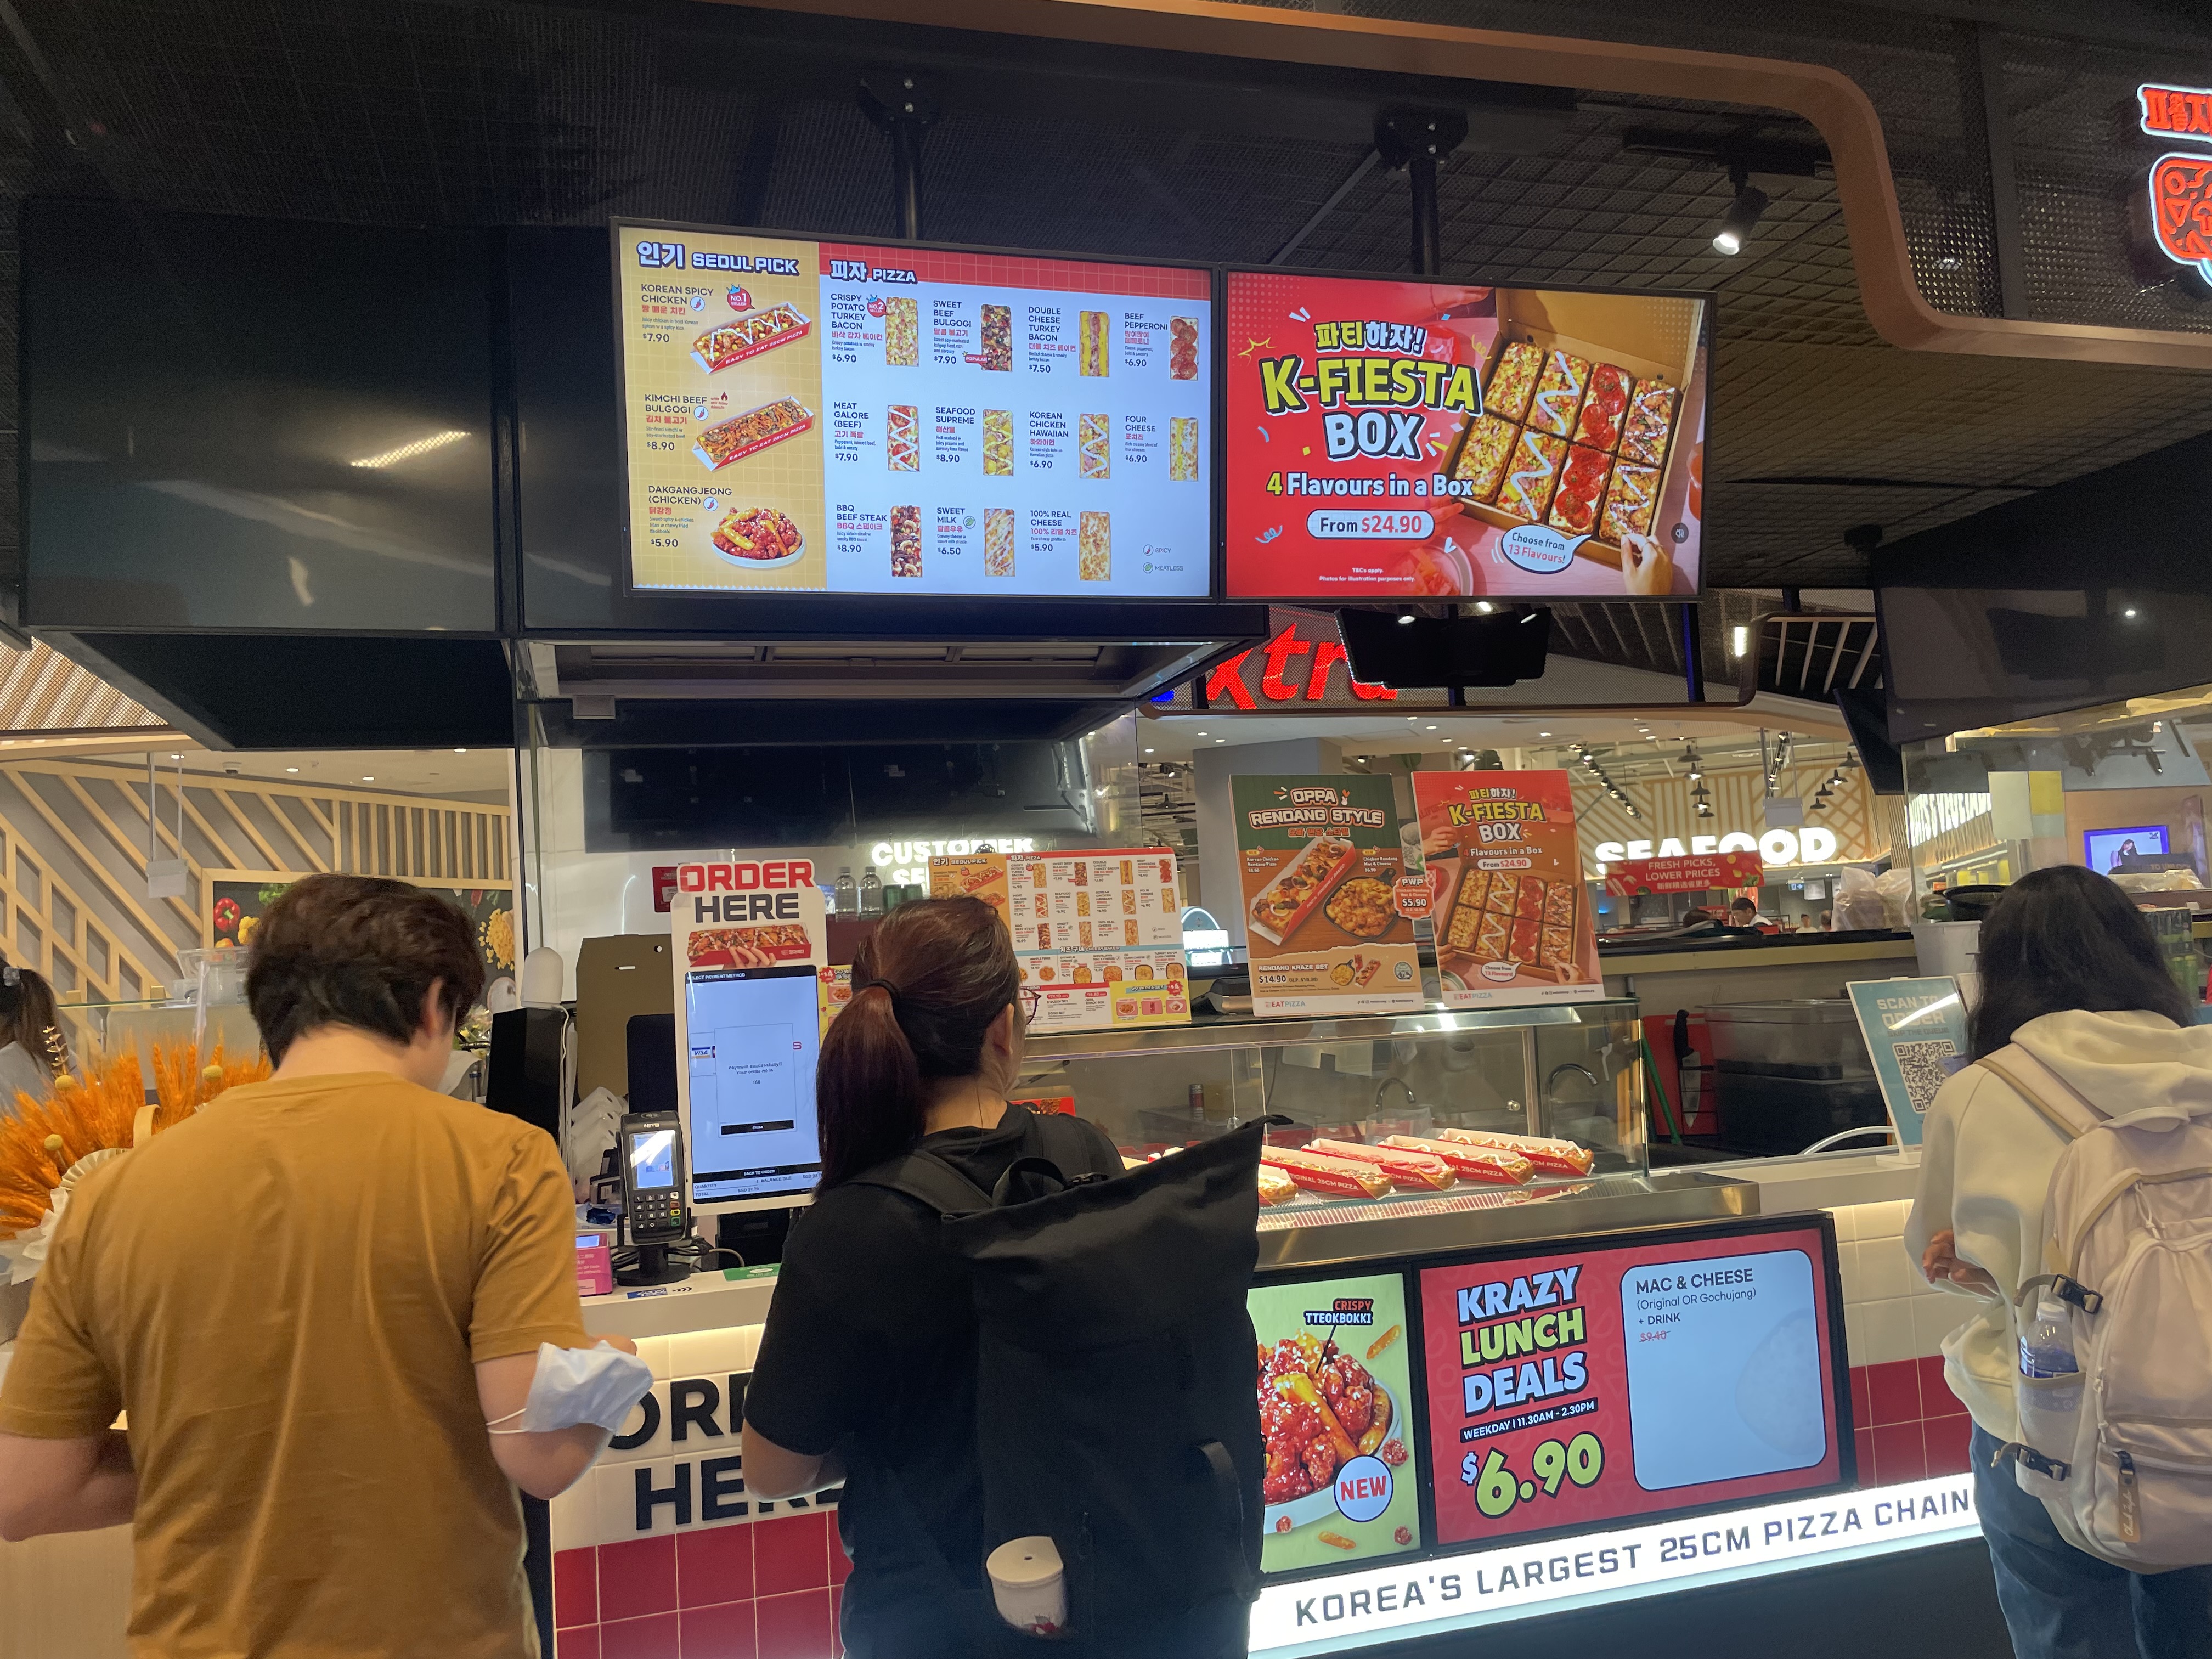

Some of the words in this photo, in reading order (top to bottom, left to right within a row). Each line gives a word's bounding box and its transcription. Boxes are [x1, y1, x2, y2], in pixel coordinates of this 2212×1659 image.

[637, 241, 685, 269] 인기
[692, 252, 753, 273] SEOUL
[755, 257, 800, 275] PICK
[830, 259, 867, 283] 피자
[872, 268, 918, 284] PIZZA
[641, 284, 682, 294] KOREAN
[685, 287, 713, 296] SPICY
[641, 295, 687, 304] CHICKEN
[731, 293, 747, 303] NO.1
[831, 303, 865, 311] POTATO
[1029, 306, 1061, 314] DOUBLE
[831, 312, 866, 320] TURKEY
[1029, 315, 1060, 324] CHEESE
[934, 319, 971, 328] BULGOGI
[643, 334, 669, 342] $7.90
[1315, 320, 1426, 355] 파티하자!
[726, 355, 744, 364] EASY
[756, 343, 768, 352] EAT
[769, 336, 786, 347] 25CM
[787, 330, 803, 340] PIZZA
[832, 354, 856, 363] $6.90
[1125, 359, 1147, 367] $6.90
[1260, 356, 1480, 415] K-FIESTA
[645, 394, 680, 403] KIMCHI
[683, 396, 707, 404] BEEF
[645, 405, 690, 414] BULGOGI
[936, 407, 975, 415] SEAFOOD
[834, 420, 861, 428] (BEEF)
[936, 416, 974, 424] SUPREME
[1323, 411, 1424, 459] BOX
[647, 442, 675, 450] $8.90
[835, 453, 858, 462] $7.90
[936, 454, 960, 463] $8.90
[1030, 460, 1052, 469] $6.90
[1266, 472, 1283, 496] 4
[1286, 472, 1385, 496] Flavours
[1389, 473, 1410, 496] in
[1414, 479, 1426, 496] a
[1432, 474, 1474, 496] Box
[648, 486, 732, 495] DAKGANGJEONG
[648, 496, 701, 505] (CHICKEN)
[1321, 517, 1358, 532] From
[1362, 515, 1421, 533] $24.90
[651, 539, 678, 548] $5.90
[1512, 532, 1543, 546] Choose
[1545, 539, 1565, 550] from
[837, 544, 861, 552] $8.90
[938, 547, 961, 555] $6.50
[1031, 544, 1053, 552] $5.90
[1508, 544, 1520, 555] 13
[1522, 545, 1565, 564] Flavours!
[1291, 788, 1338, 805] OPPA
[1469, 788, 1517, 800] 파티하자!
[1250, 808, 1328, 827] RENDANG
[1331, 809, 1384, 827] STYLE
[1448, 802, 1547, 827] K-FIESTA
[1479, 823, 1523, 842] BOX
[1470, 848, 1508, 856] Flavours
[1527, 846, 1542, 854] Box
[1595, 827, 1837, 874] SEAFOOD
[1649, 860, 1680, 870] FRESH
[1684, 858, 1716, 868] PICKS,
[680, 861, 814, 892] ORDER
[1646, 871, 1682, 881] LOWER
[1685, 868, 1720, 878] PRICES
[1402, 878, 1423, 886] PWP
[695, 893, 799, 923] HERE
[1402, 898, 1427, 907] $5.90
[1876, 997, 1917, 1010] SCAN
[1636, 1277, 1672, 1294] MAC
[1677, 1276, 1687, 1289] &
[1691, 1268, 1753, 1288] CHEESE
[1458, 1265, 1581, 1324] KRAZY
[1637, 1297, 1679, 1311] (Original
[1683, 1295, 1697, 1305] OR
[1700, 1288, 1756, 1303] Gochujang)
[1334, 1299, 1372, 1311] CRISPY
[1305, 1312, 1372, 1324] TTEOKBOKKI
[1648, 1313, 1680, 1325] DRINK
[1460, 1307, 1585, 1368] LUNCH
[1640, 1330, 1667, 1342] $9.40
[1463, 1351, 1587, 1415] DEALS
[1464, 1423, 1510, 1440] WEEKDAY
[1517, 1410, 1554, 1427] 11.30AM
[1561, 1401, 1594, 1418] 2.30PM
[1461, 1432, 1604, 1518] $6.90
[1341, 1476, 1386, 1502] NEW
[1295, 1573, 1463, 1627] KOREA'S
[1476, 1542, 1646, 1595] LARGEST
[1660, 1524, 1752, 1564] 25CM
[1763, 1510, 1863, 1547] PIZZA
[1874, 1489, 1969, 1528] CHAIN
